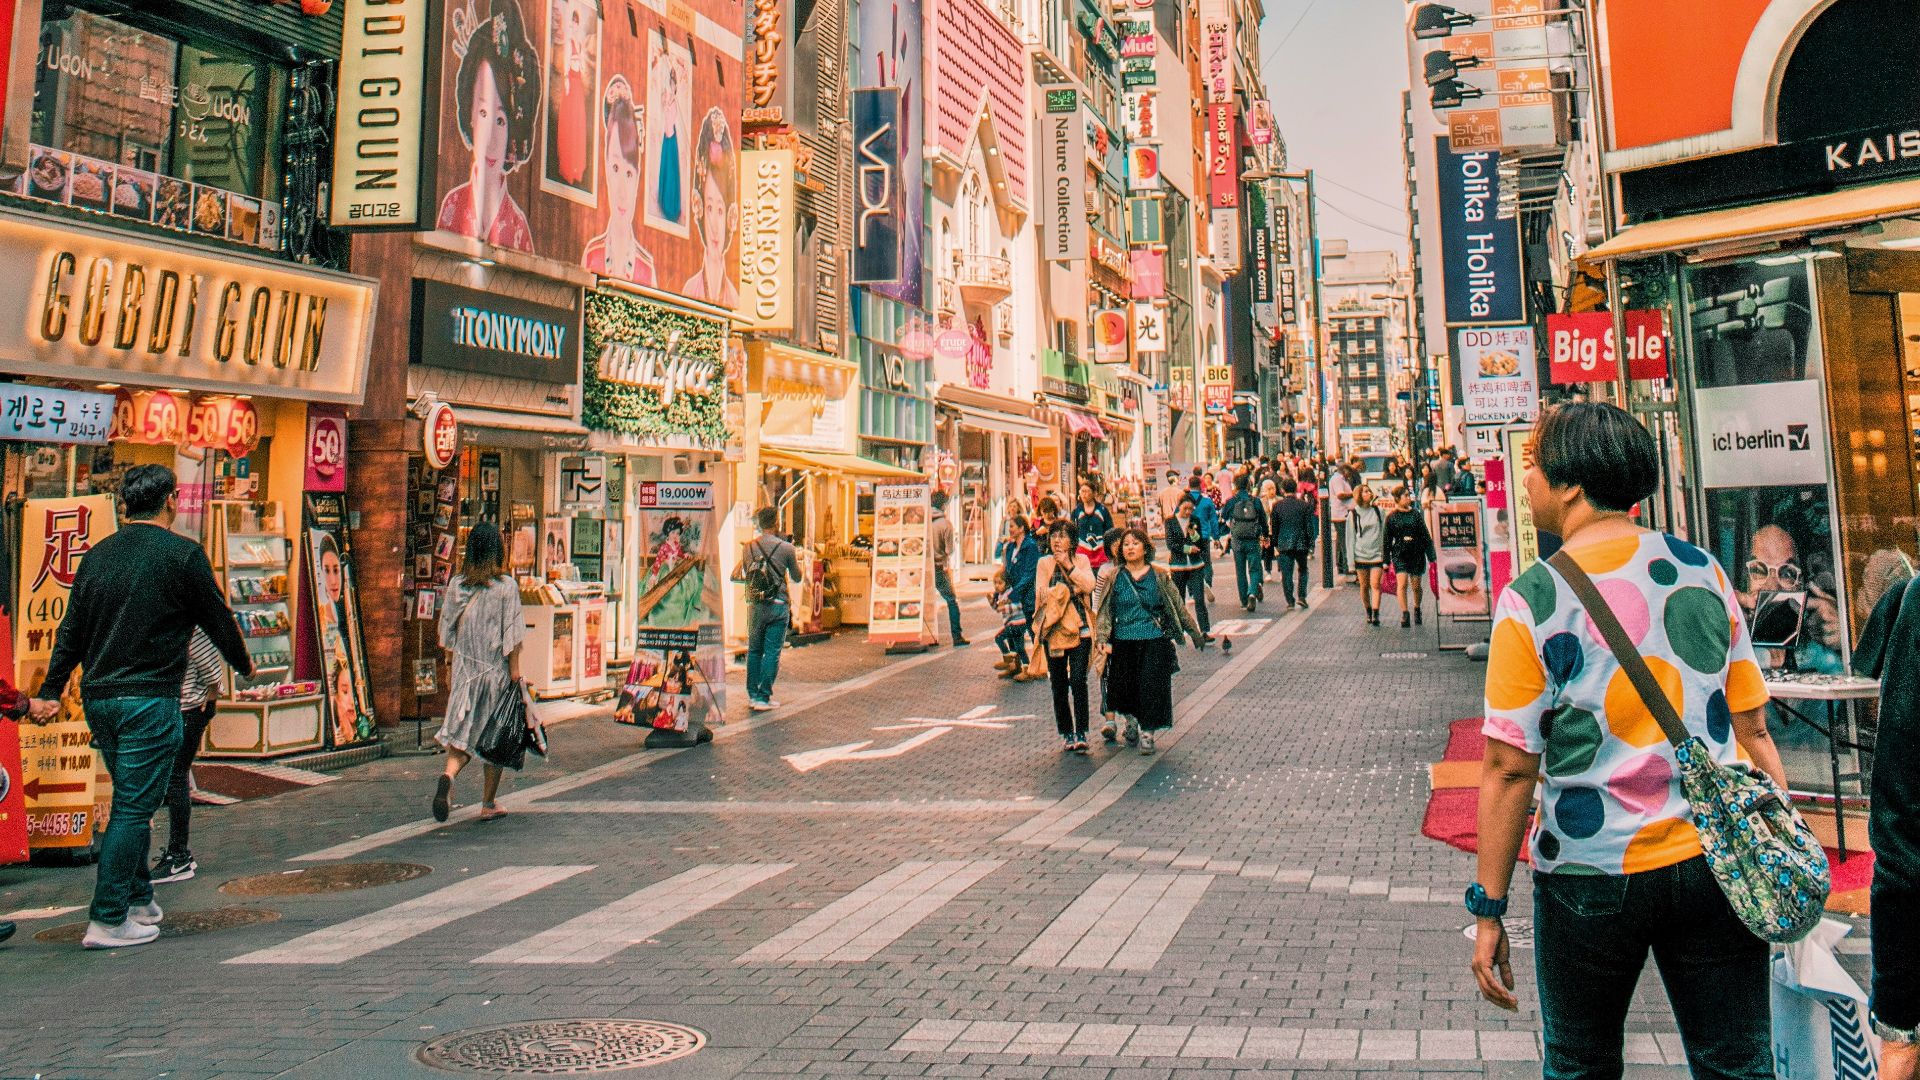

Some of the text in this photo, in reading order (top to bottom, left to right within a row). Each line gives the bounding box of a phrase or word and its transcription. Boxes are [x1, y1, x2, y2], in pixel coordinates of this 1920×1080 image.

[1120, 37, 1157, 54] Mud
[355, 77, 401, 190] GOUN
[859, 121, 891, 248] VDL
[1055, 117, 1070, 258] Nature Collection
[349, 202, 401, 219] 곱디고운
[1221, 193, 1234, 204] 3F
[755, 159, 782, 321] SKINFOOD
[1256, 229, 1267, 300] HOLLYS COFFEE
[1466, 232, 1496, 318] Holika
[40, 252, 328, 372] GOBDI GOUN
[1138, 315, 1160, 340] 光
[1466, 332, 1492, 347] DD
[1554, 330, 1598, 371] Big
[882, 354, 913, 389] VDL
[1208, 368, 1229, 381] BIG
[1207, 386, 1230, 400] MART
[80, 402, 101, 420] 우동
[314, 429, 339, 464] 50
[1712, 429, 1784, 451] ic! berlin
[882, 488, 923, 500] 乌达里家
[32, 505, 91, 593] 足
[60, 754, 91, 771] ₩18,000
[26, 813, 69, 836] 5-4455
[72, 812, 88, 834] 3F
